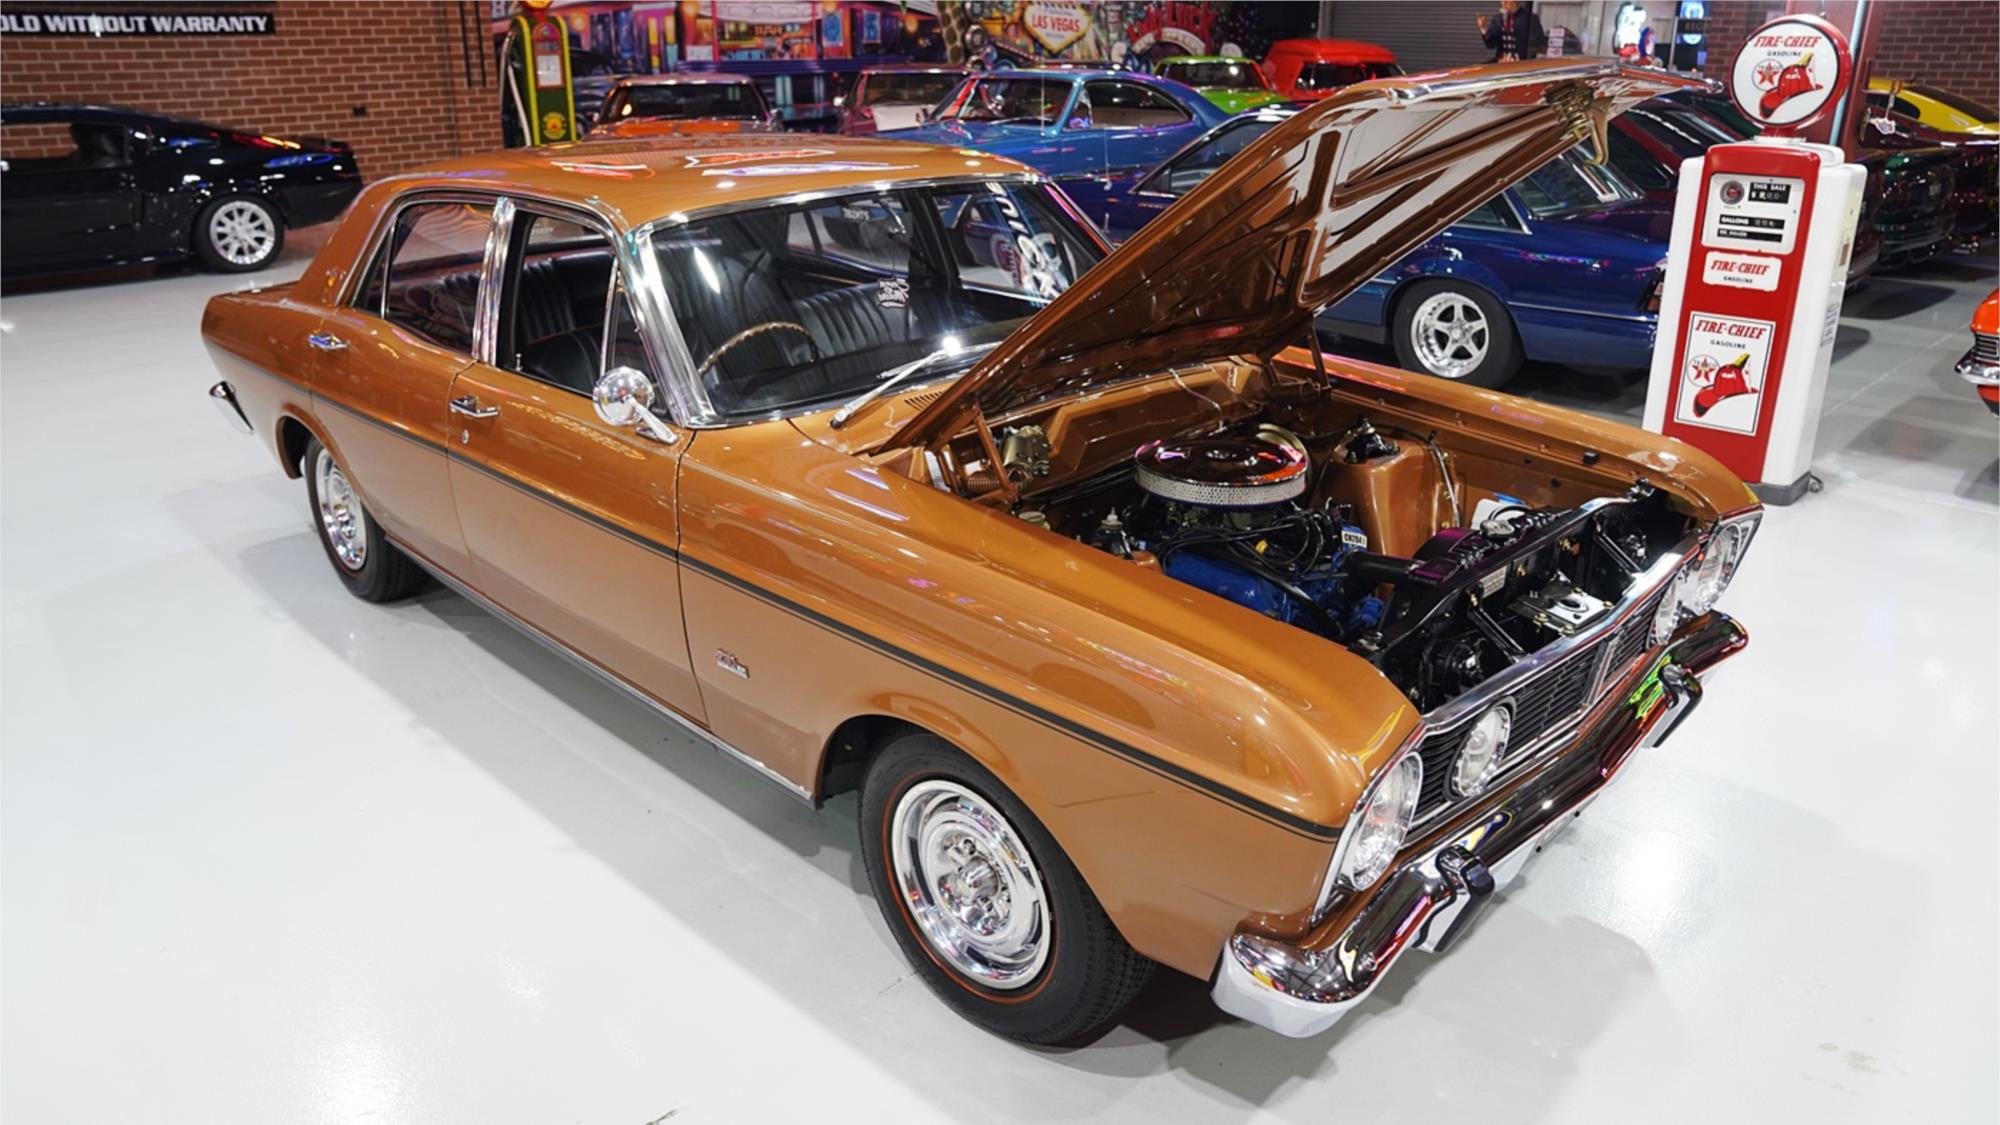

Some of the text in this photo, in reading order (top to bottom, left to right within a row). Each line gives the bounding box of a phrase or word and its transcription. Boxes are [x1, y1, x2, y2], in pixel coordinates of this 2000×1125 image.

[43, 14, 147, 33] WITHOUT
[150, 16, 268, 32] WARRANTY
[1031, 14, 1080, 32] LAS VEGAS
[1754, 36, 1822, 48] FIRE-CHIEF
[1720, 216, 1749, 225] GALLONS
[1710, 259, 1770, 275] FIRE-CHIEF
[1723, 276, 1753, 284] GASOLINE
[1695, 319, 1767, 340] FIRE-CHIEF
[1710, 339, 1747, 349] GASOLINE
